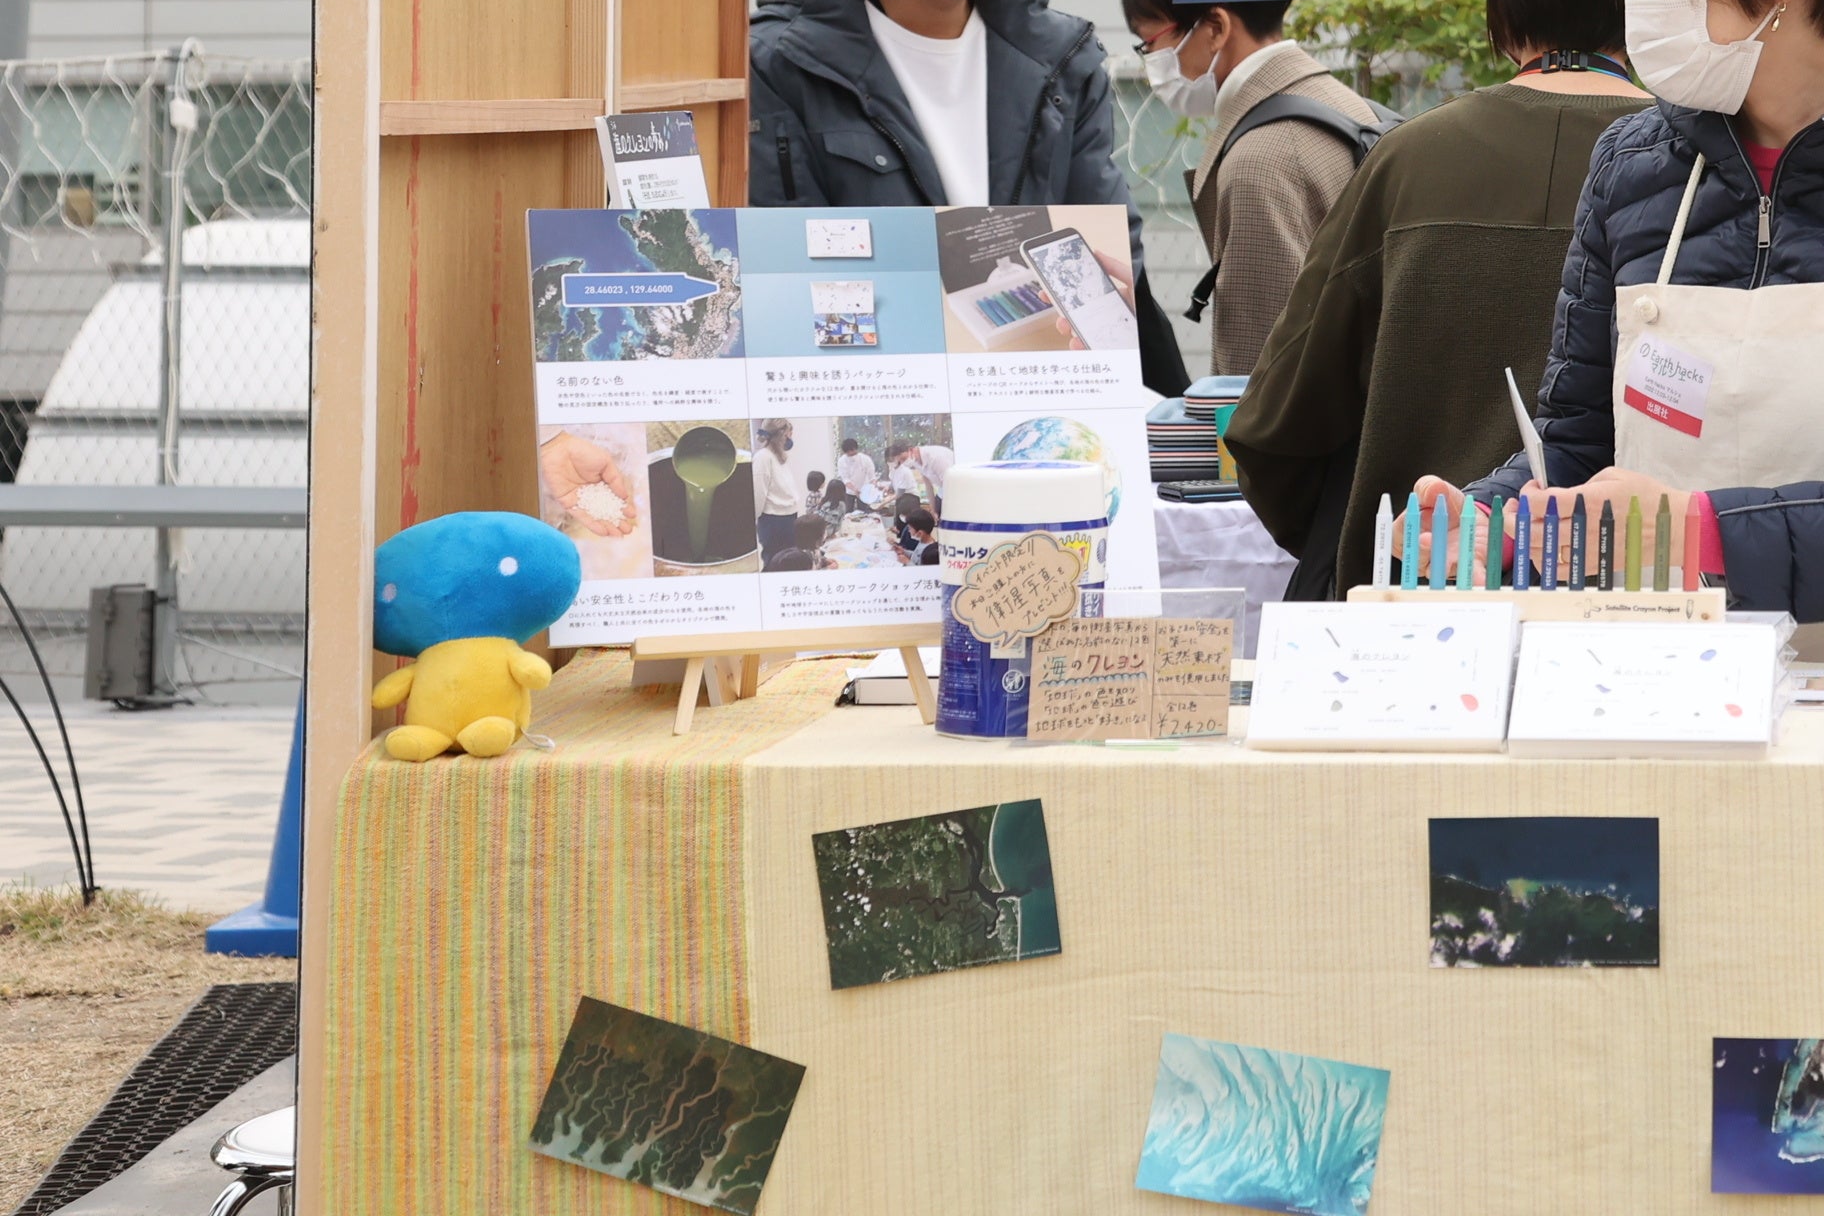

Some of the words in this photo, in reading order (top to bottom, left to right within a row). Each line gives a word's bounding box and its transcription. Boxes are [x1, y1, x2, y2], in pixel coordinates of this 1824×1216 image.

[584, 285, 623, 295] 28.46023
[630, 284, 673, 294] 129.64000
[965, 363, 1113, 377] 色を通して地球を学べる仕組み
[1651, 349, 1674, 371] Earth
[1674, 361, 1704, 384] hacks
[556, 375, 625, 387] 名前のない色
[765, 368, 907, 382] 驚きと興味を誘うパッケージ
[1657, 606, 1681, 614] Project
[1169, 636, 1197, 648] 第一に
[1042, 654, 1145, 680] 海のクレヨン
[1166, 701, 1198, 713] 全12色
